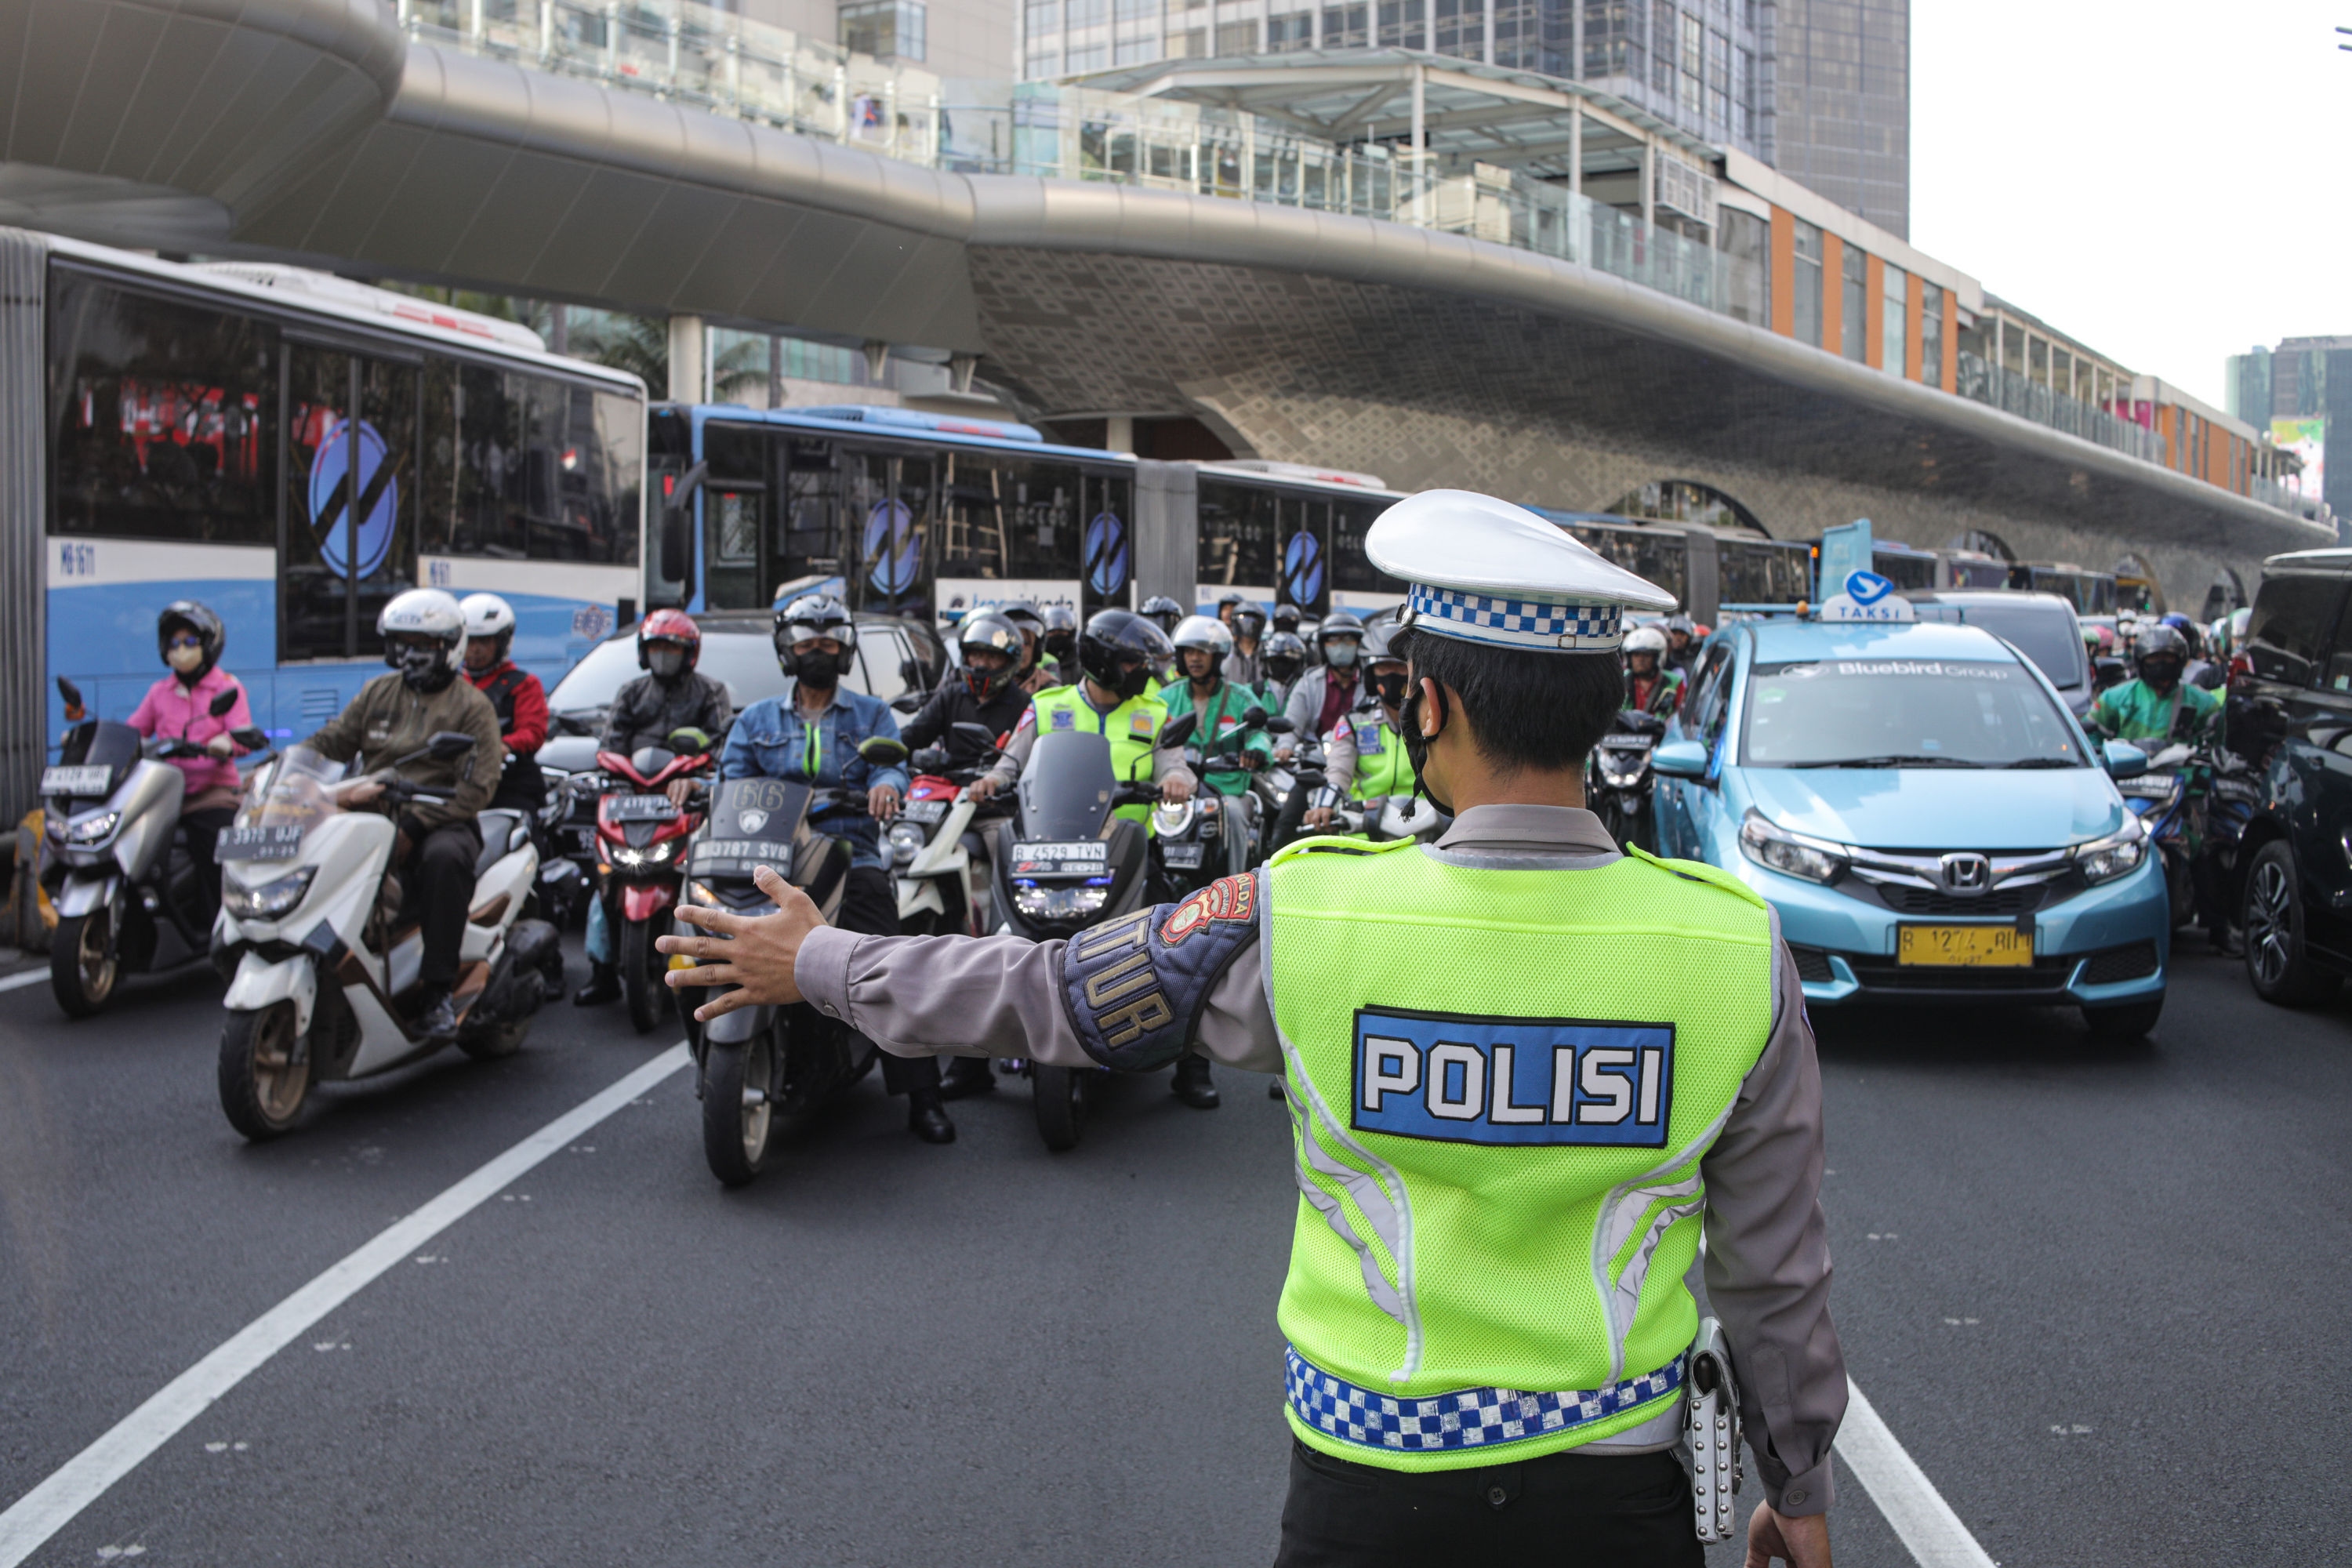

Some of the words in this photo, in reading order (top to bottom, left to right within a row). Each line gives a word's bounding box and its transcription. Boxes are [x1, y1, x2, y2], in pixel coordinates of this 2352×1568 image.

[1839, 606, 1900, 619] TAKSI
[1838, 661, 1943, 675] Bluebird
[1945, 666, 2009, 680] Group
[731, 779, 786, 812] 66
[219, 829, 229, 847] B
[713, 841, 750, 857] 3787
[1016, 848, 1024, 861] B
[1033, 847, 1068, 861] 4529
[1077, 846, 1102, 860] TVN
[1903, 929, 1914, 952] B
[1361, 1034, 1663, 1125] POLISI
